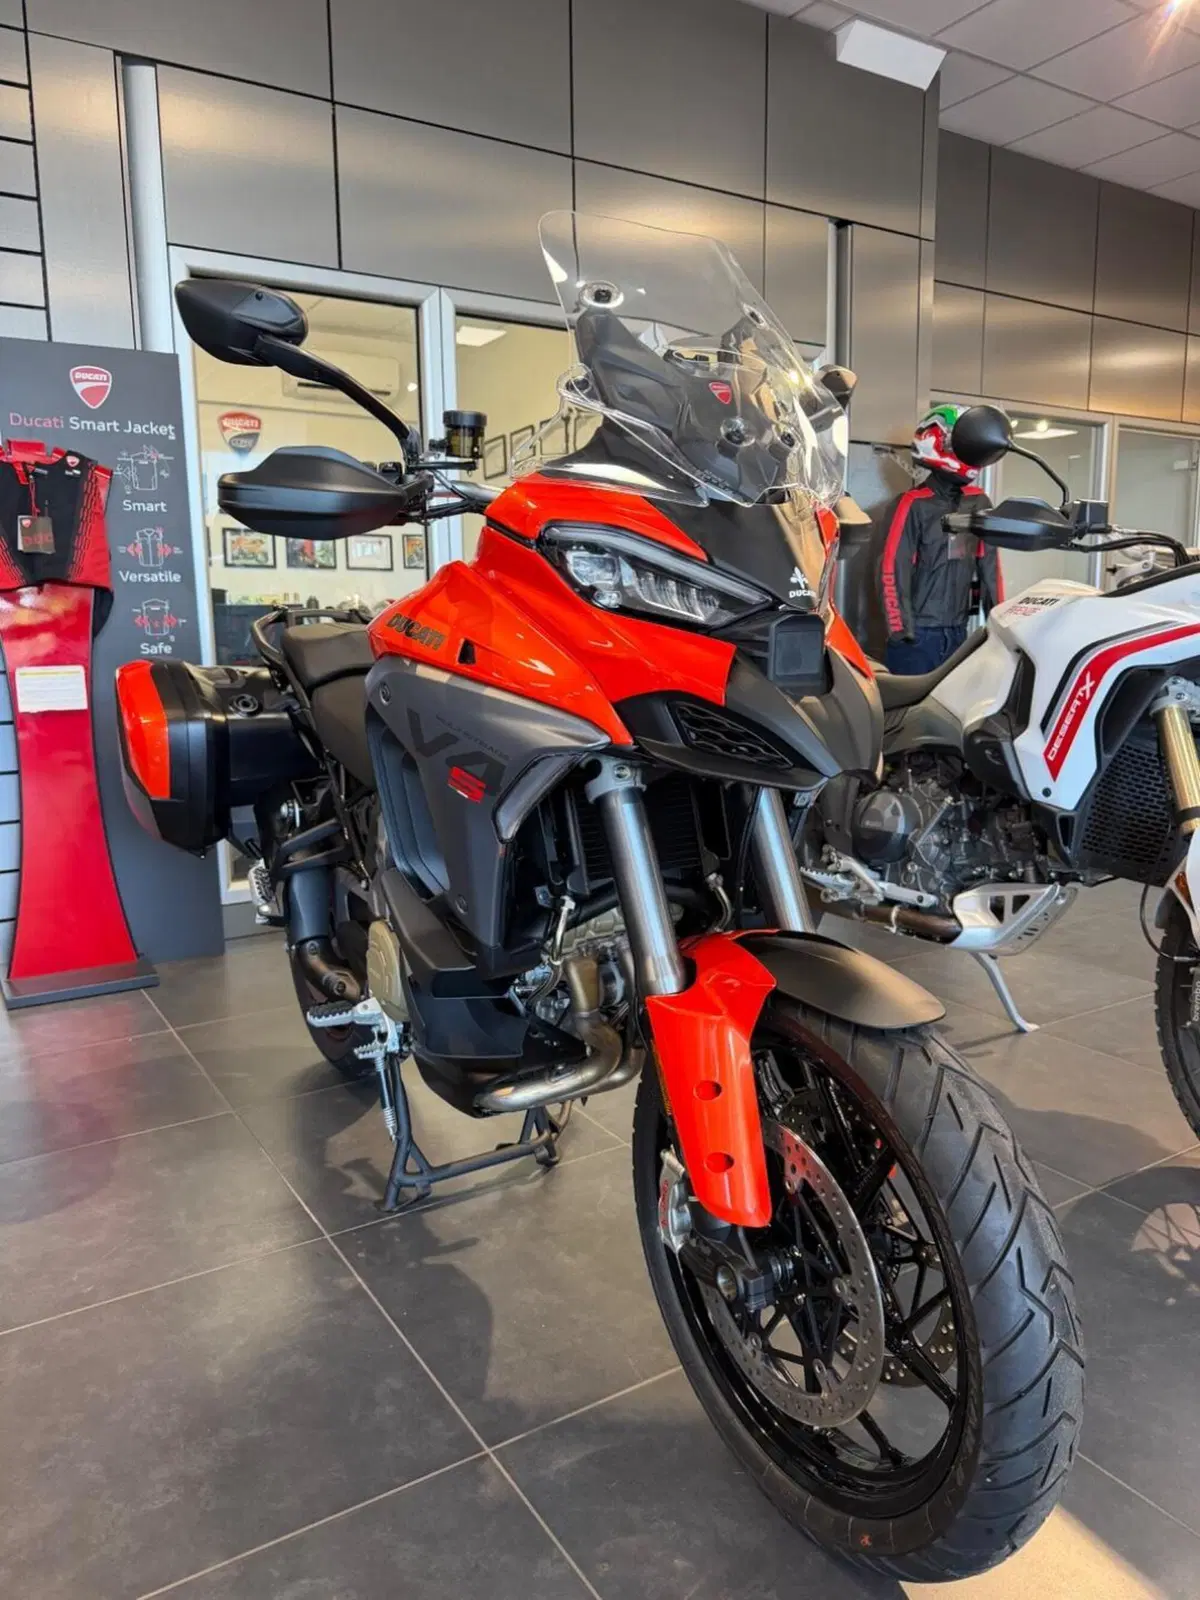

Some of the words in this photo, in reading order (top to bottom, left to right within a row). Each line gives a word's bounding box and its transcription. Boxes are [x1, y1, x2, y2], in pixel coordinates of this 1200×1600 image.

[75, 371, 108, 382] DUCATI
[9, 412, 65, 429] Ducati
[69, 416, 120, 433] Smart
[123, 420, 175, 436] Jacket
[122, 499, 168, 512] Smart
[118, 570, 182, 583] Versatile
[387, 613, 445, 651] DUCATI
[140, 642, 173, 655] Safe
